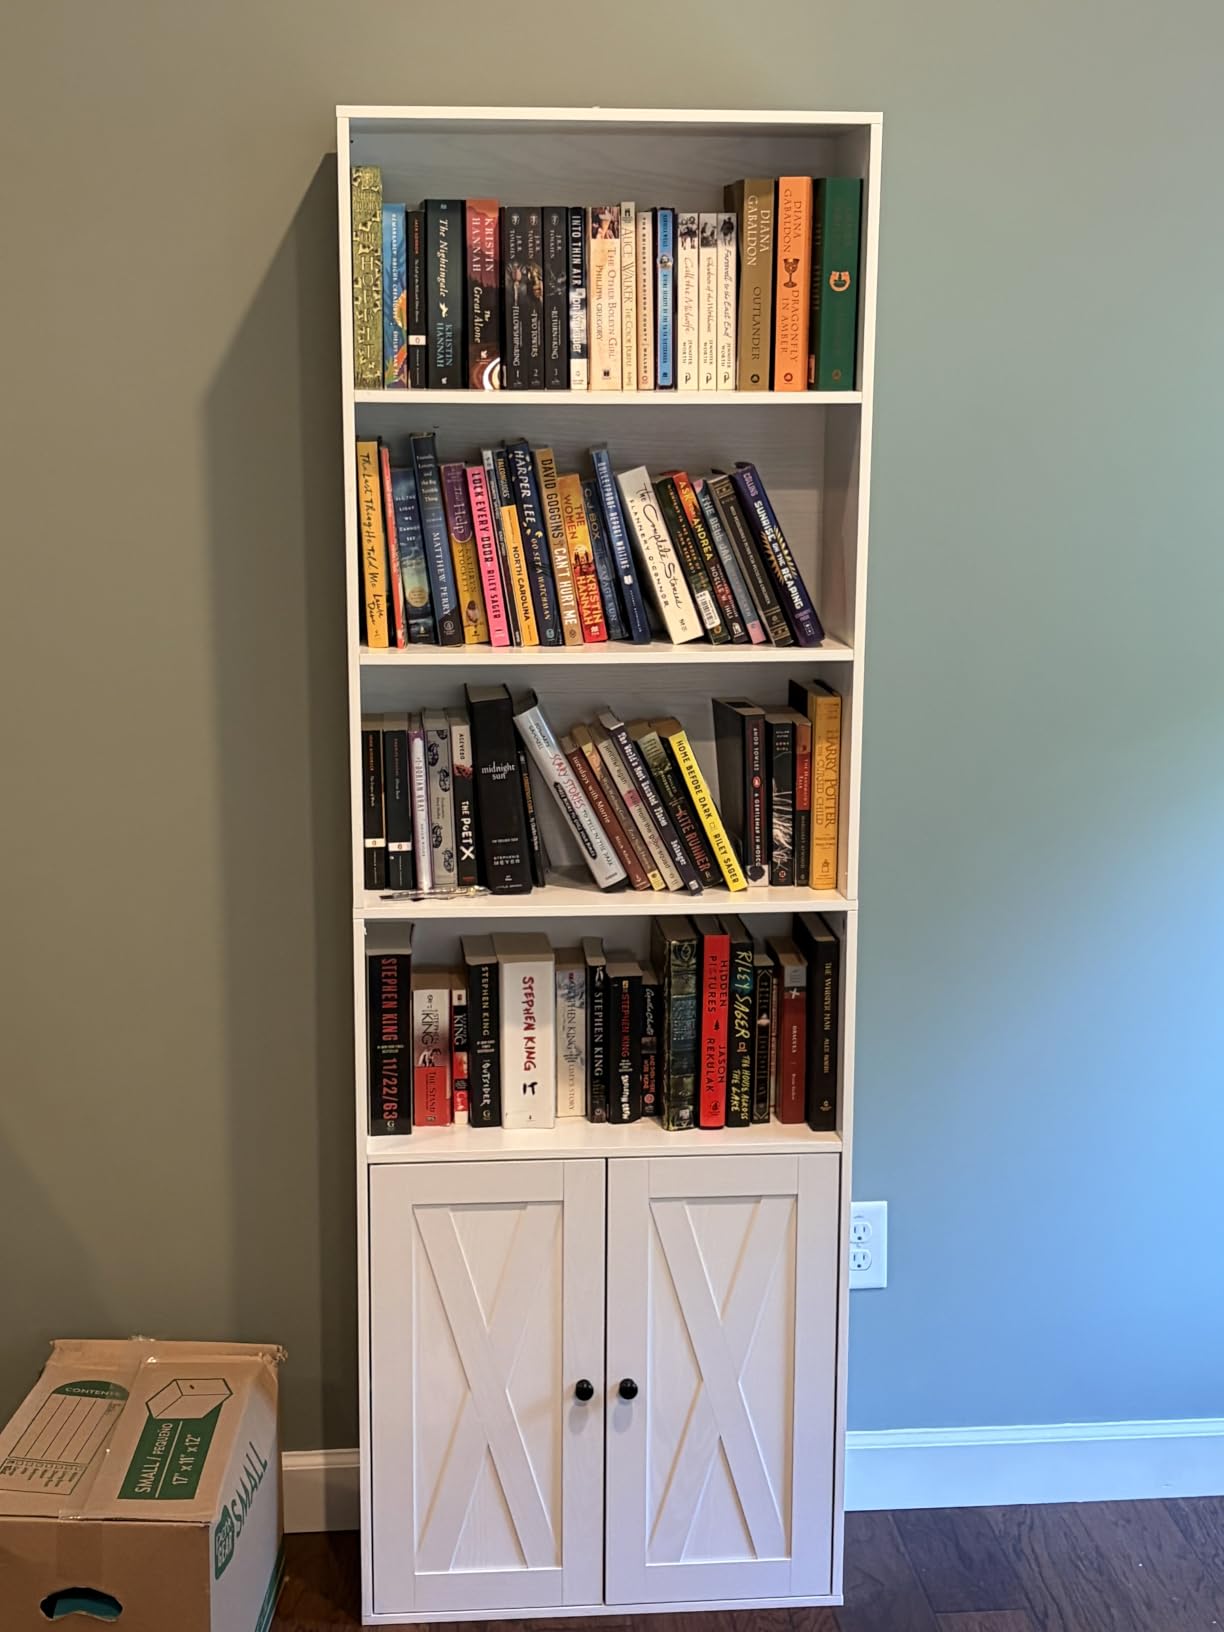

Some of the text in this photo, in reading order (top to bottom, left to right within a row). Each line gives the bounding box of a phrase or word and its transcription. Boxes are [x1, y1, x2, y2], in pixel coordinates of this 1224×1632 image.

[471, 217, 480, 271] HANNAH
[485, 217, 493, 271] KRISTIN
[746, 195, 757, 265] GABALDON
[759, 209, 770, 252] DIANA
[782, 188, 791, 252] GABALDON
[792, 200, 801, 238] DIANA
[436, 218, 448, 297] The Nightingale
[571, 215, 581, 285] INTO THIN AIR
[621, 228, 634, 303] ALICE WALKER
[642, 267, 646, 275] OF
[723, 248, 732, 282] Farewell
[473, 286, 482, 343] Great Alone
[607, 247, 617, 359] THE OTHER BOLEYN GIRL
[723, 300, 731, 317] East
[751, 286, 761, 360] OUTLANDER
[779, 297, 788, 353] IN AMBER
[789, 289, 799, 362] DRAGONFLY
[723, 321, 731, 338] End
[513, 449, 536, 524] HARPER LEE
[540, 458, 564, 539] DAVID GOGGINS
[742, 471, 759, 497] COLLINS
[470, 472, 493, 563] LOCK EVERY DOOR
[562, 494, 578, 540] WOMEN
[573, 503, 585, 526] THE
[678, 479, 714, 561] ASK ANDREA
[700, 494, 732, 563] THE BELL JAR
[753, 499, 776, 542] SUNRISE
[511, 545, 523, 576] NORTH
[532, 550, 542, 567] SET
[635, 481, 688, 609] The Complete Stories
[771, 541, 781, 553] ON
[775, 552, 786, 567] THE
[431, 531, 451, 616] MATTHEW PERRY
[485, 568, 501, 619] RILEY SAGER
[536, 575, 551, 621] WATCHMAN
[553, 546, 577, 625] CAN'T HURT ME
[585, 573, 602, 623] KRISTIN
[779, 566, 804, 610] REAPING
[516, 577, 530, 621] CAROLINA
[575, 575, 593, 625] HANNAH
[480, 759, 515, 775] midnight
[815, 759, 824, 793] CURSED
[824, 729, 837, 773] HARRY
[570, 754, 612, 825] tuesdays with Morrie
[675, 739, 713, 819] HOME BEFORE DARK
[823, 779, 836, 829] POTTER
[674, 808, 695, 834] KITE
[815, 797, 824, 826] CHILD
[684, 830, 712, 872] RUNNER
[712, 832, 740, 884] RILEY SAGER
[381, 958, 397, 1008] STEPHEN
[719, 960, 727, 1006] HIDDEN
[733, 950, 751, 1038] RILEY SAGER
[823, 978, 831, 1011] WHISPER
[381, 1013, 397, 1040] KING
[421, 1012, 432, 1044] KING
[453, 1015, 463, 1045] KING
[521, 976, 535, 1071] STEPHEN KING
[593, 991, 602, 1076] STEPHEN KING
[621, 993, 629, 1032] STEPHEN
[381, 1057, 397, 1119] 11/22/63
[705, 1038, 713, 1092] REKULAK
[717, 1045, 725, 1083] JASON
[740, 1055, 749, 1120] THE HOUSE ACROSS
[730, 1069, 739, 1112] THE LAKE
[134, 1460, 160, 1493] SMALL
[152, 1422, 174, 1455] PEQUEÑO
[231, 1441, 268, 1539] SMALL
